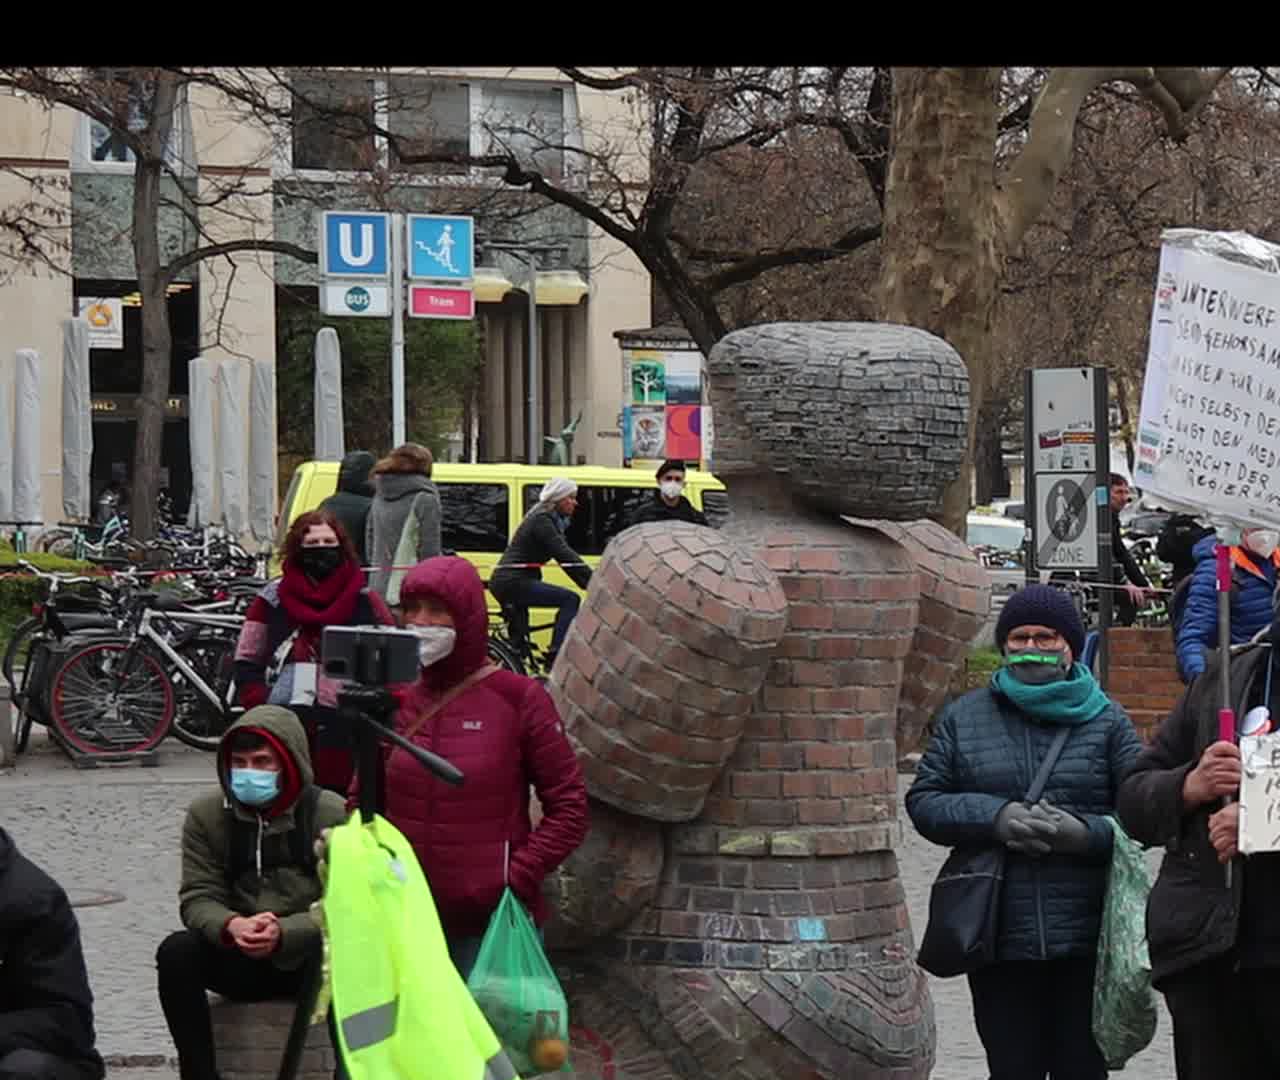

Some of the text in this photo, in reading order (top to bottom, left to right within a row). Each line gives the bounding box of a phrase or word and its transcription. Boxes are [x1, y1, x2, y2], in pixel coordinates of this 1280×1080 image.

[339, 223, 374, 267] U
[346, 292, 369, 306] BUS
[429, 295, 455, 307] Tram
[1051, 546, 1084, 563] ZONE
